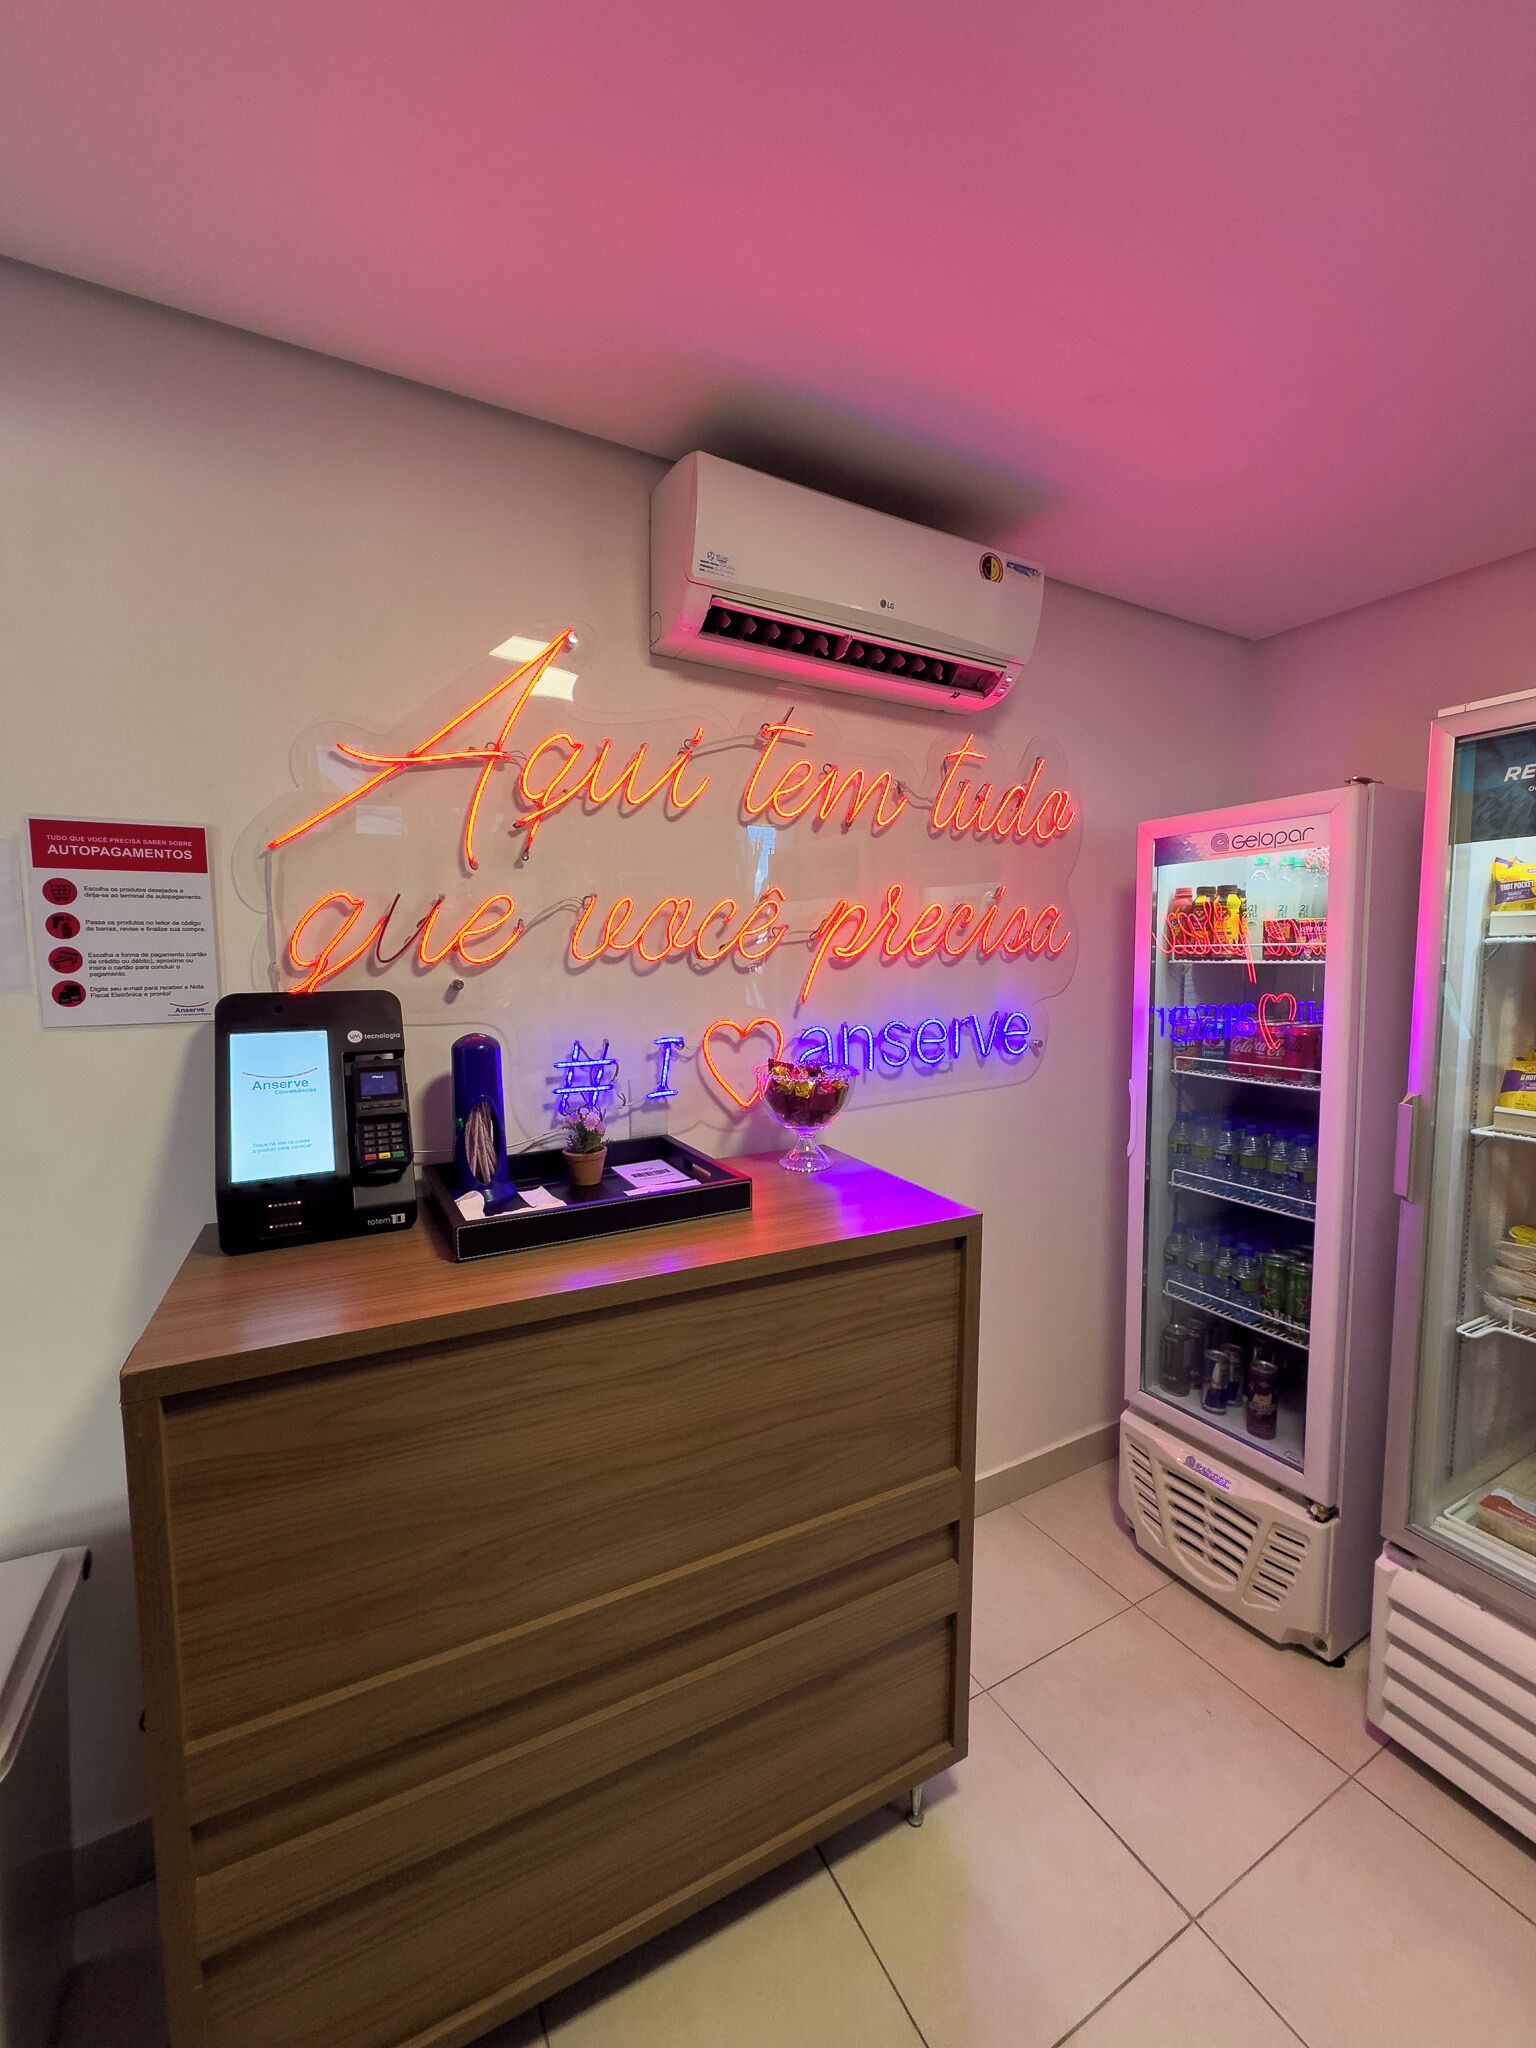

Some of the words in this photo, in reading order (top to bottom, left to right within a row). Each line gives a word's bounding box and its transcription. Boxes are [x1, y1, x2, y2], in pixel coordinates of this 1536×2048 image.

[887, 601, 895, 610] LG
[268, 627, 710, 870] Aqui
[745, 706, 908, 827] tem
[931, 733, 1076, 841] tudo
[1231, 826, 1315, 850] Gelopar
[47, 844, 193, 860] AUTOPAGAMENTOS
[288, 890, 525, 994] que
[571, 886, 789, 963] você
[801, 884, 1071, 1005] precisa
[364, 1032, 400, 1040] tecnologia
[799, 1010, 1032, 1072] anserve
[252, 1080, 309, 1090] Anserve
[368, 1218, 391, 1226] totem
